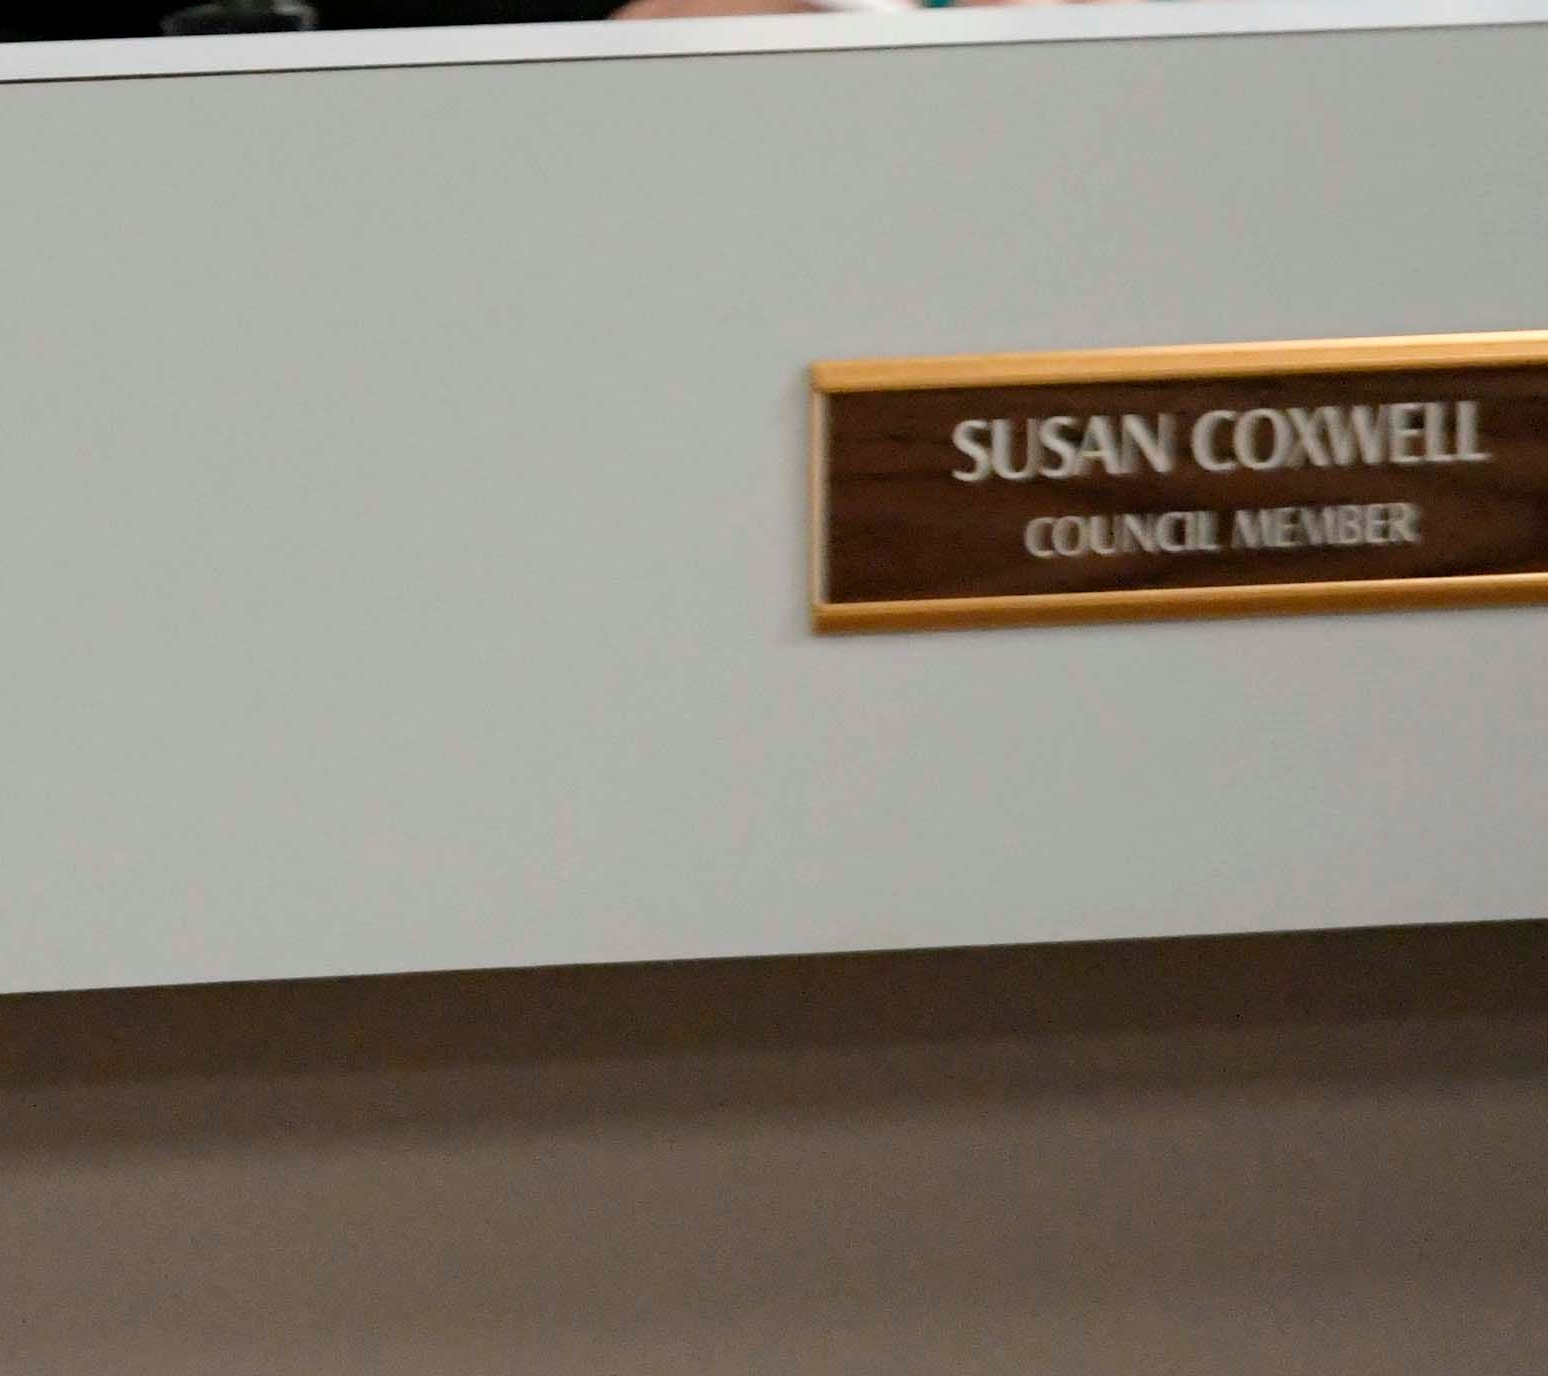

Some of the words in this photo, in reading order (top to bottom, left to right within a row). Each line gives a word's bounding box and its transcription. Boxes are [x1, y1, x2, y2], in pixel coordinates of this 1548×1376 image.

[952, 412, 1174, 484] SUSAN
[1192, 400, 1491, 472] COXWELL
[1024, 510, 1219, 559] COUNCIL
[1233, 501, 1420, 550] MEMBER
